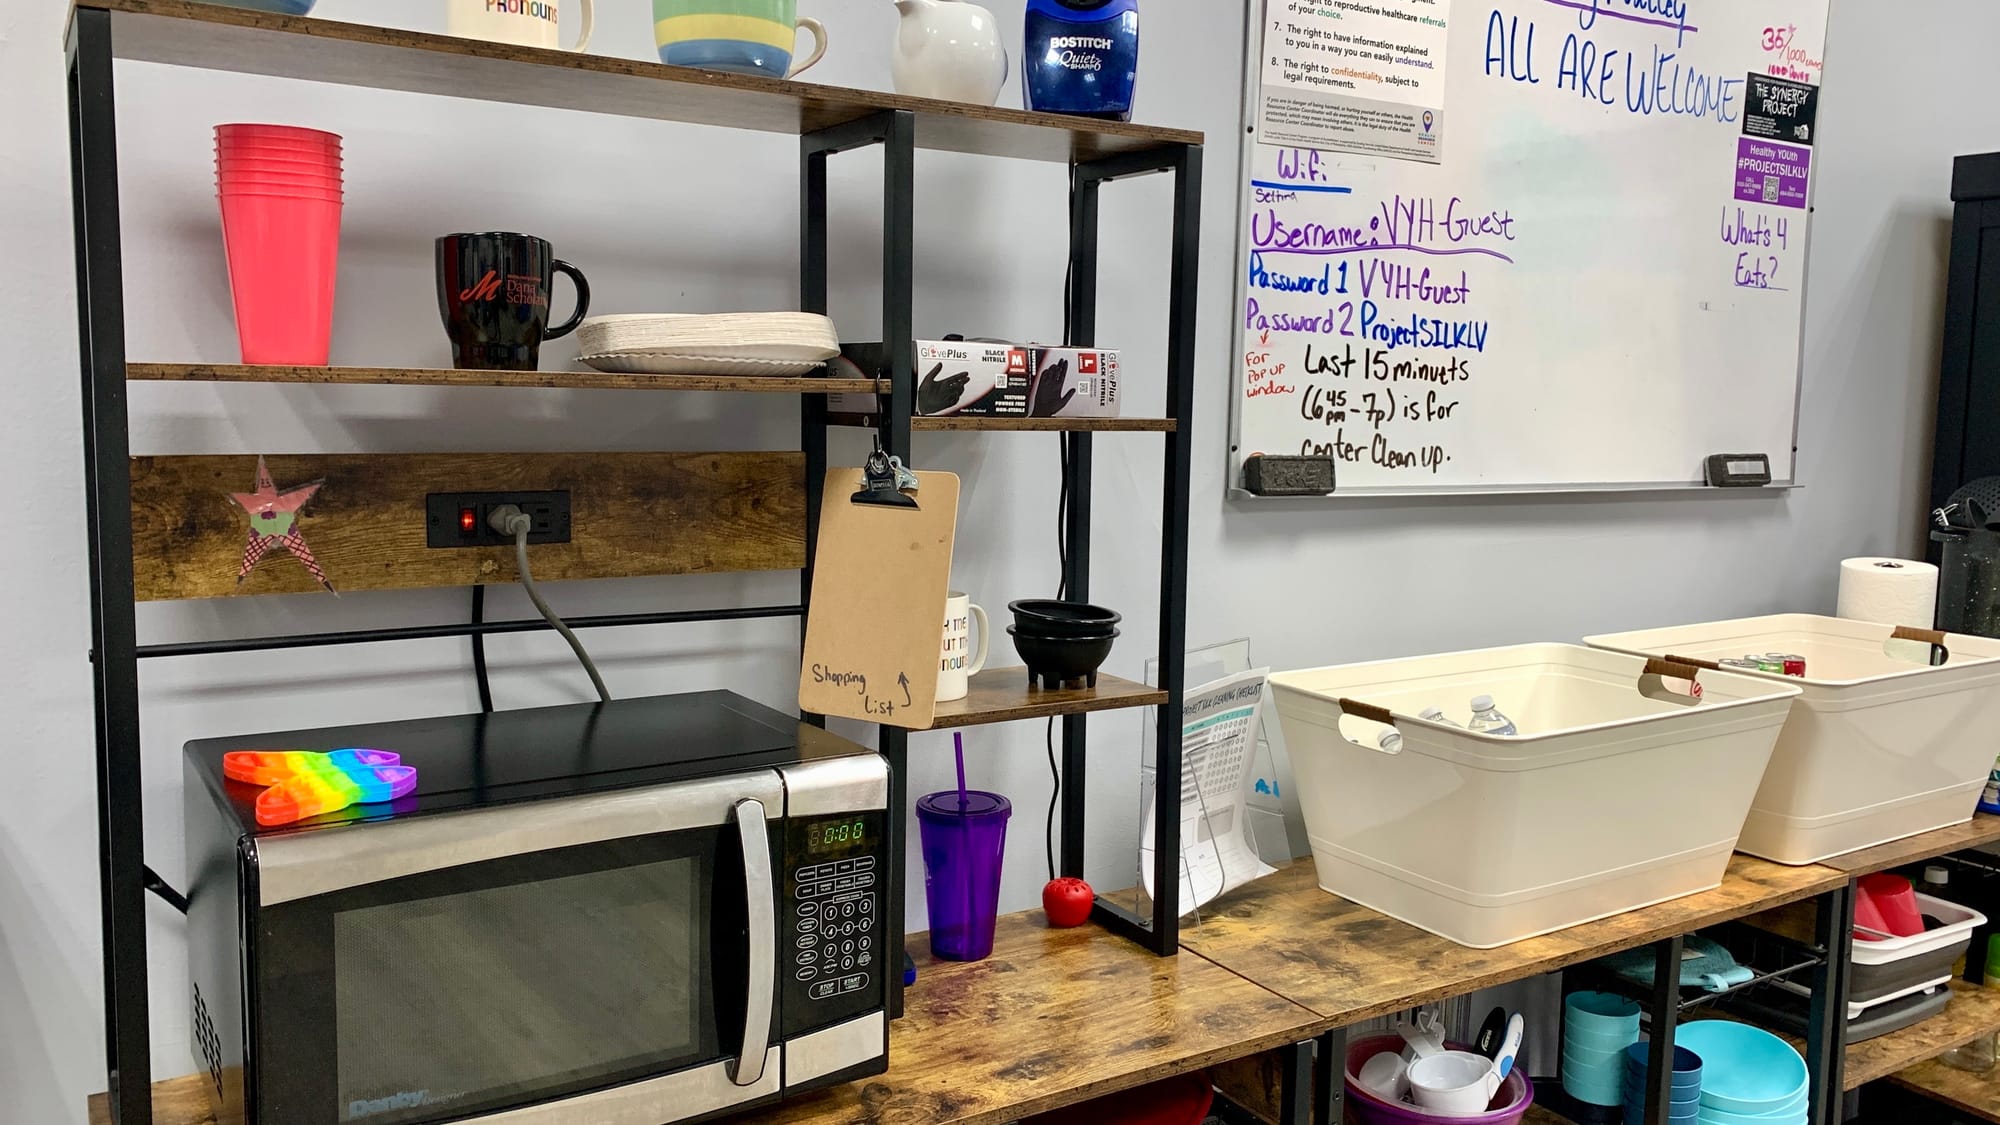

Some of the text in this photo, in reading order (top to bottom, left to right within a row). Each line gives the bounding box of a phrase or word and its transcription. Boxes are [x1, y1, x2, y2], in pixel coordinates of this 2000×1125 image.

[1288, 2, 1343, 20] of your choice.
[1334, 1, 1380, 15] reproductive
[1381, 7, 1417, 22] healthcare
[1419, 15, 1446, 28] referrals
[1050, 37, 1111, 50] BOSTITCH
[1273, 21, 1429, 56] 7. The right to have information explained
[1285, 37, 1294, 45] to
[1295, 40, 1310, 49] you
[1312, 41, 1319, 50] in
[1327, 45, 1343, 56] way
[1344, 48, 1358, 57] you
[1359, 50, 1372, 59] can
[1374, 53, 1393, 64] easily
[1395, 56, 1434, 69] understand.
[1271, 56, 1279, 66] 8.
[1283, 58, 1298, 69] The
[1300, 61, 1319, 73] right
[1321, 65, 1329, 73] to
[1331, 67, 1383, 84] confidentiality,
[1385, 75, 1409, 87] subject
[1486, 10, 1539, 83] ALL
[1557, 33, 1618, 105] ARE
[1626, 44, 1744, 122] WELCOME
[1283, 69, 1356, 88] legal requirements.
[1755, 83, 1769, 98] THE
[1770, 86, 1809, 105] SYNERGY
[1762, 98, 1798, 118] PROJECT
[1750, 144, 1798, 162] Healthy YOUth
[1738, 157, 1808, 179] #PROJECTSILKLV
[1720, 205, 1788, 250] What's 4
[1249, 251, 1470, 304] Password 1 VYH-Guest
[1735, 251, 1778, 288] Eats?
[507, 280, 536, 294] Dana
[1246, 297, 1488, 352] Password 2 ProjectSILKLV
[1011, 355, 1023, 366] M
[1304, 344, 1356, 379] Last
[1365, 348, 1389, 381] 15
[1247, 382, 1295, 398] window
[1404, 396, 1420, 421] is
[1427, 390, 1459, 421] for
[1371, 433, 1416, 468] Clean
[812, 663, 866, 695] Shopping
[864, 695, 894, 717] List
[824, 822, 864, 844] 0:00
[863, 902, 868, 910] 3
[846, 924, 850, 932] 5
[845, 943, 850, 951] 8
